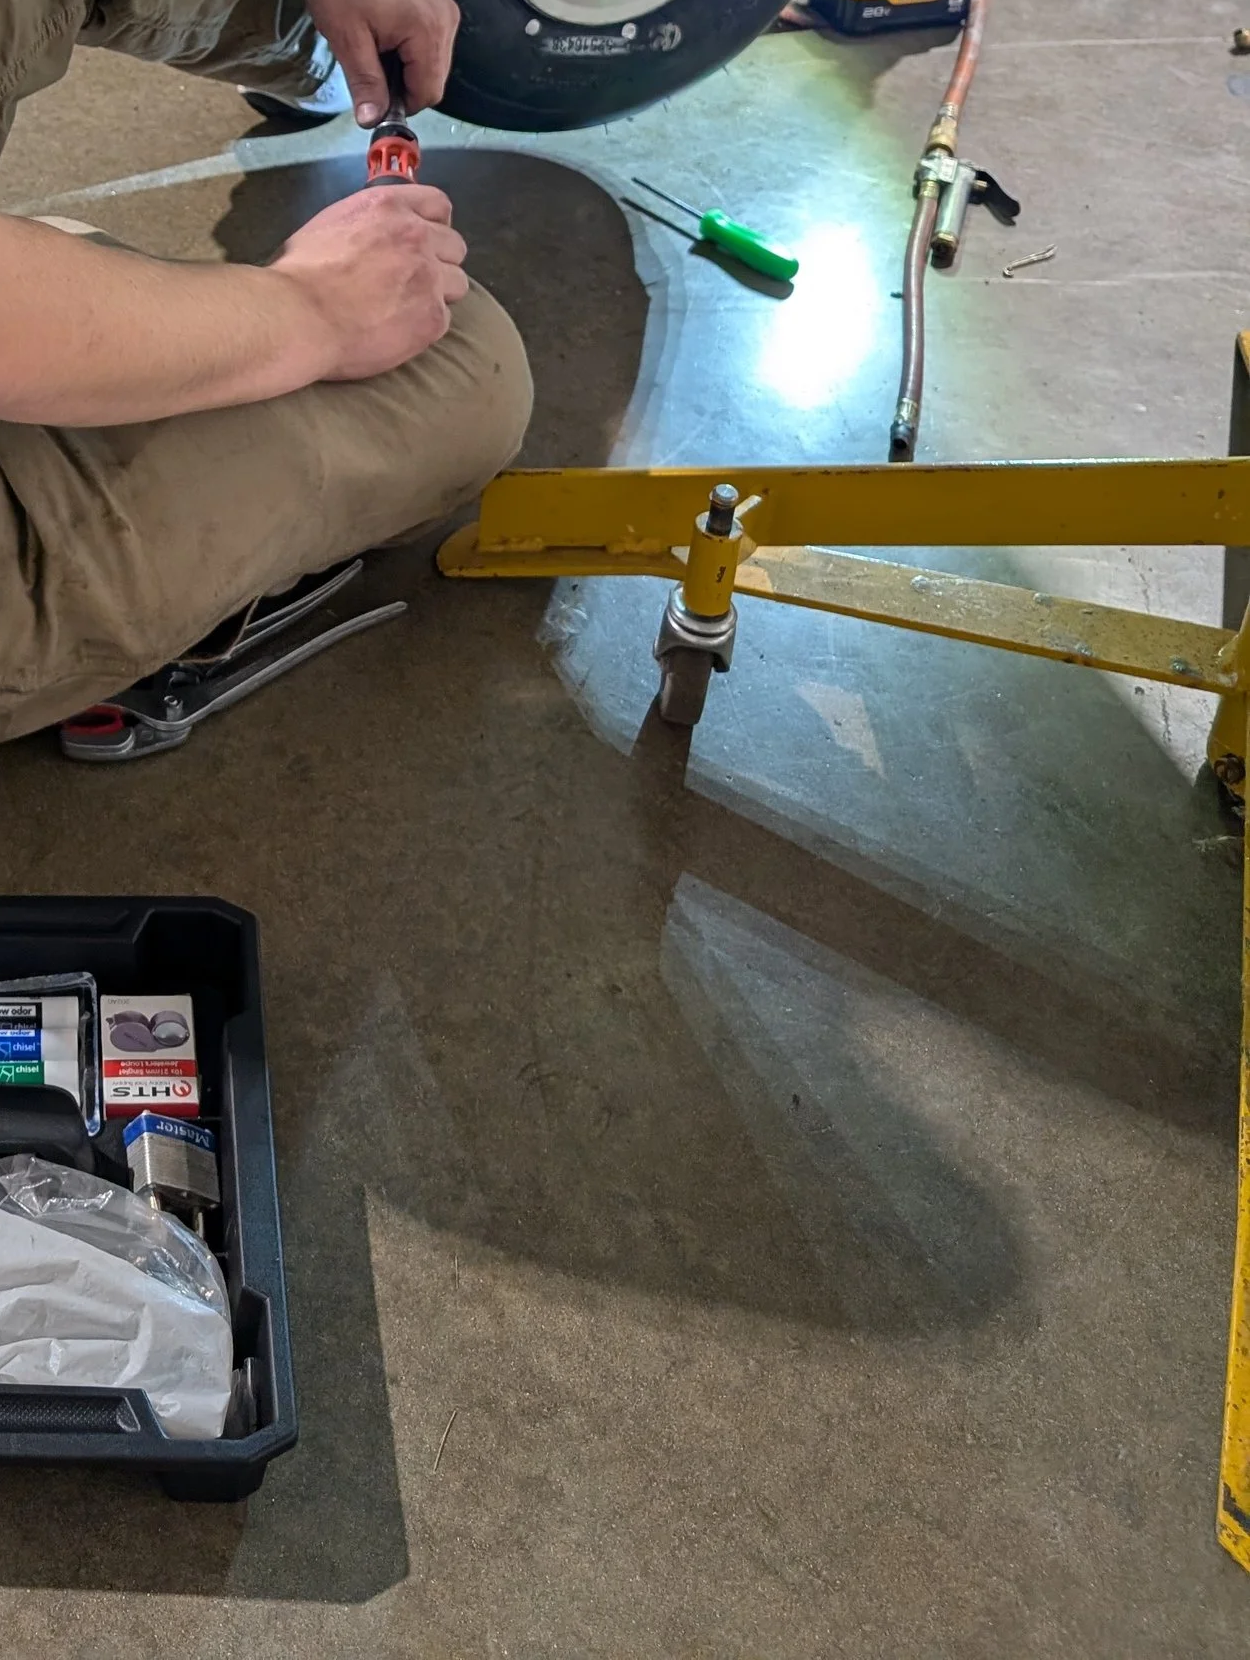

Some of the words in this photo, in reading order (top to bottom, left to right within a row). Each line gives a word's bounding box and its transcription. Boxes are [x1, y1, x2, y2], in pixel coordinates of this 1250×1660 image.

[10, 1006, 32, 1015] odor
[12, 1041, 36, 1052] chisel
[15, 1065, 40, 1073] chisel
[118, 1067, 144, 1076] Singlet
[112, 1086, 171, 1097] HTS
[155, 1120, 211, 1148] Master
